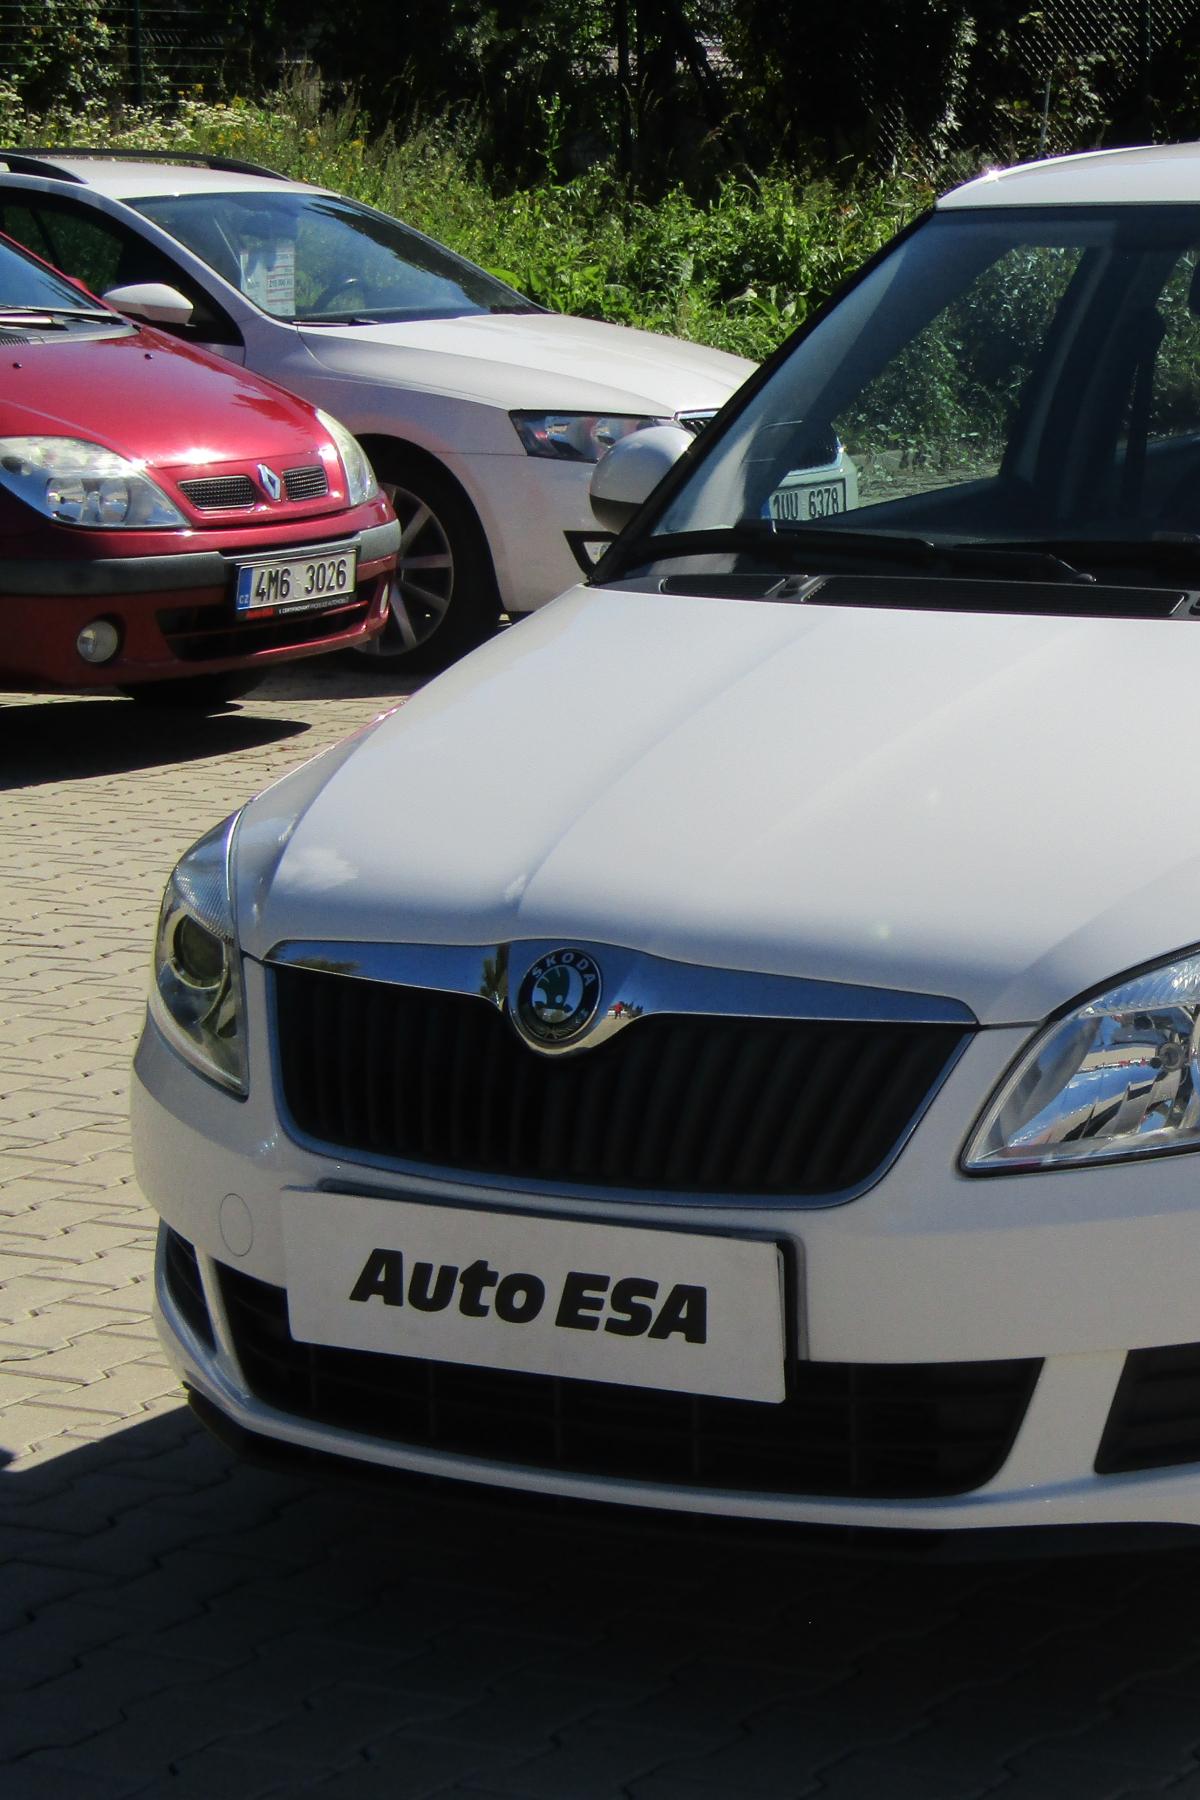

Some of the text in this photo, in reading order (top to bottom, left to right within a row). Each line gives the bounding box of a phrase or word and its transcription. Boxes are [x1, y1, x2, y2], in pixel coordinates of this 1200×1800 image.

[772, 487, 839, 520] 1UU 6378
[239, 594, 249, 604] CZ
[255, 558, 347, 602] 4M6 3026
[349, 1247, 707, 1344] Auto ESA
